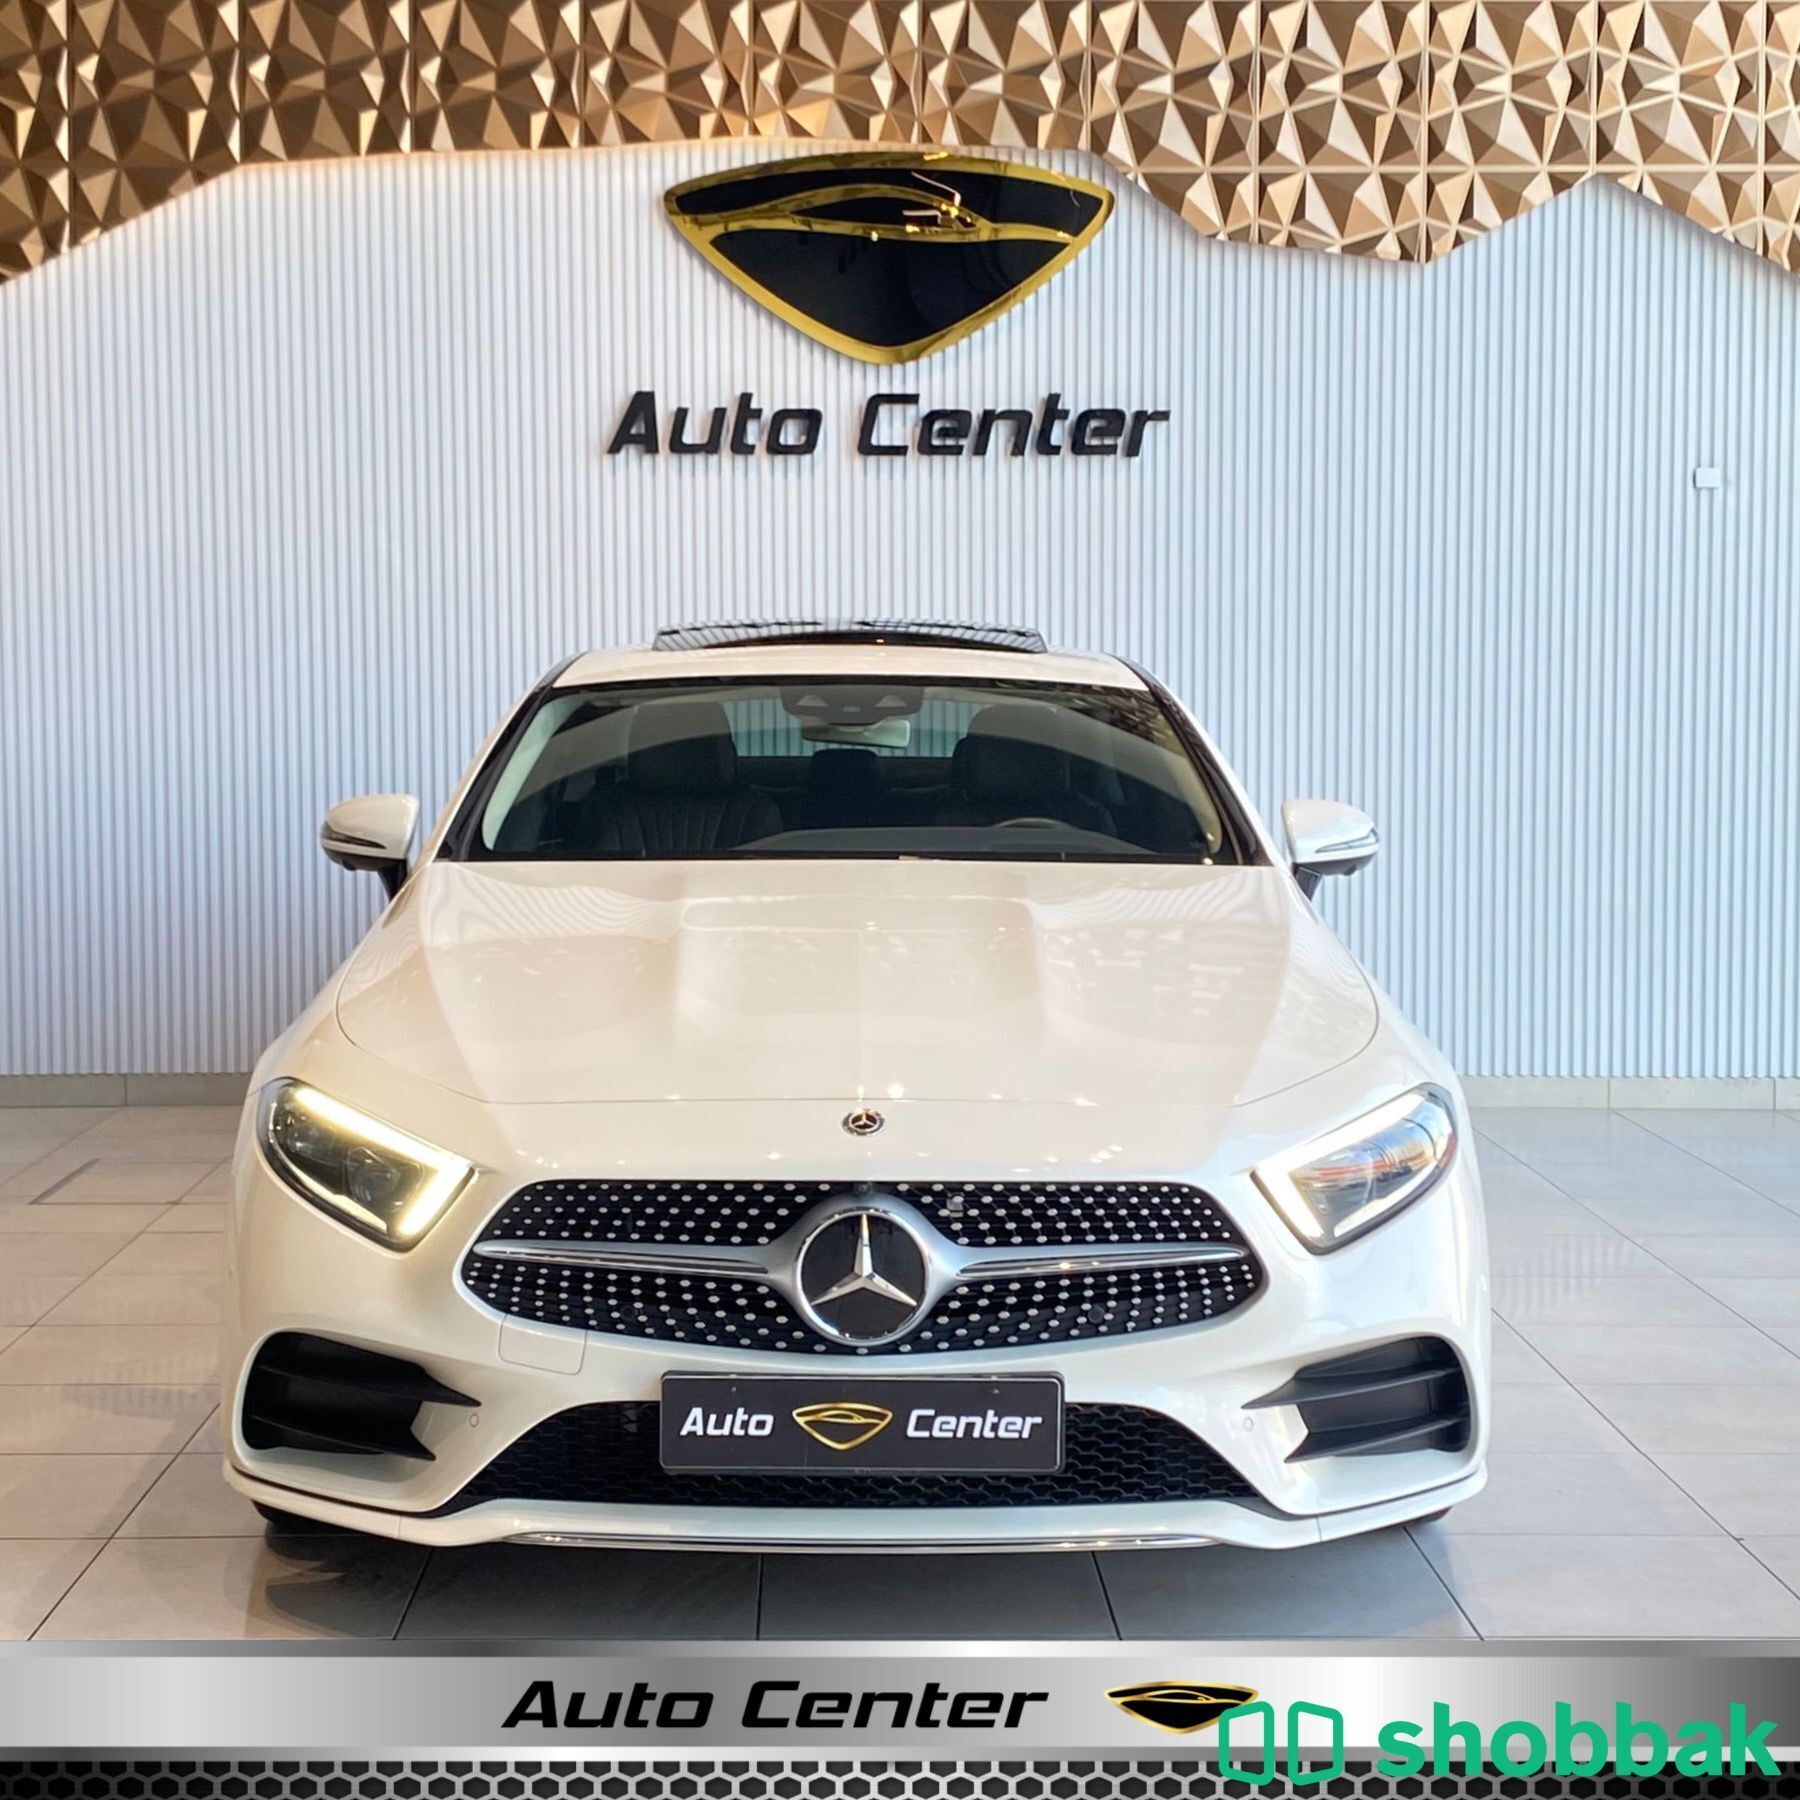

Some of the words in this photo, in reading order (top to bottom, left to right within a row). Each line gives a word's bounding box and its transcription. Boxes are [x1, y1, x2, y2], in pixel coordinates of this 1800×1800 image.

[607, 390, 822, 455] Auto
[857, 392, 1170, 457] Center
[680, 1407, 774, 1436] Auto
[906, 1409, 1042, 1439] Center
